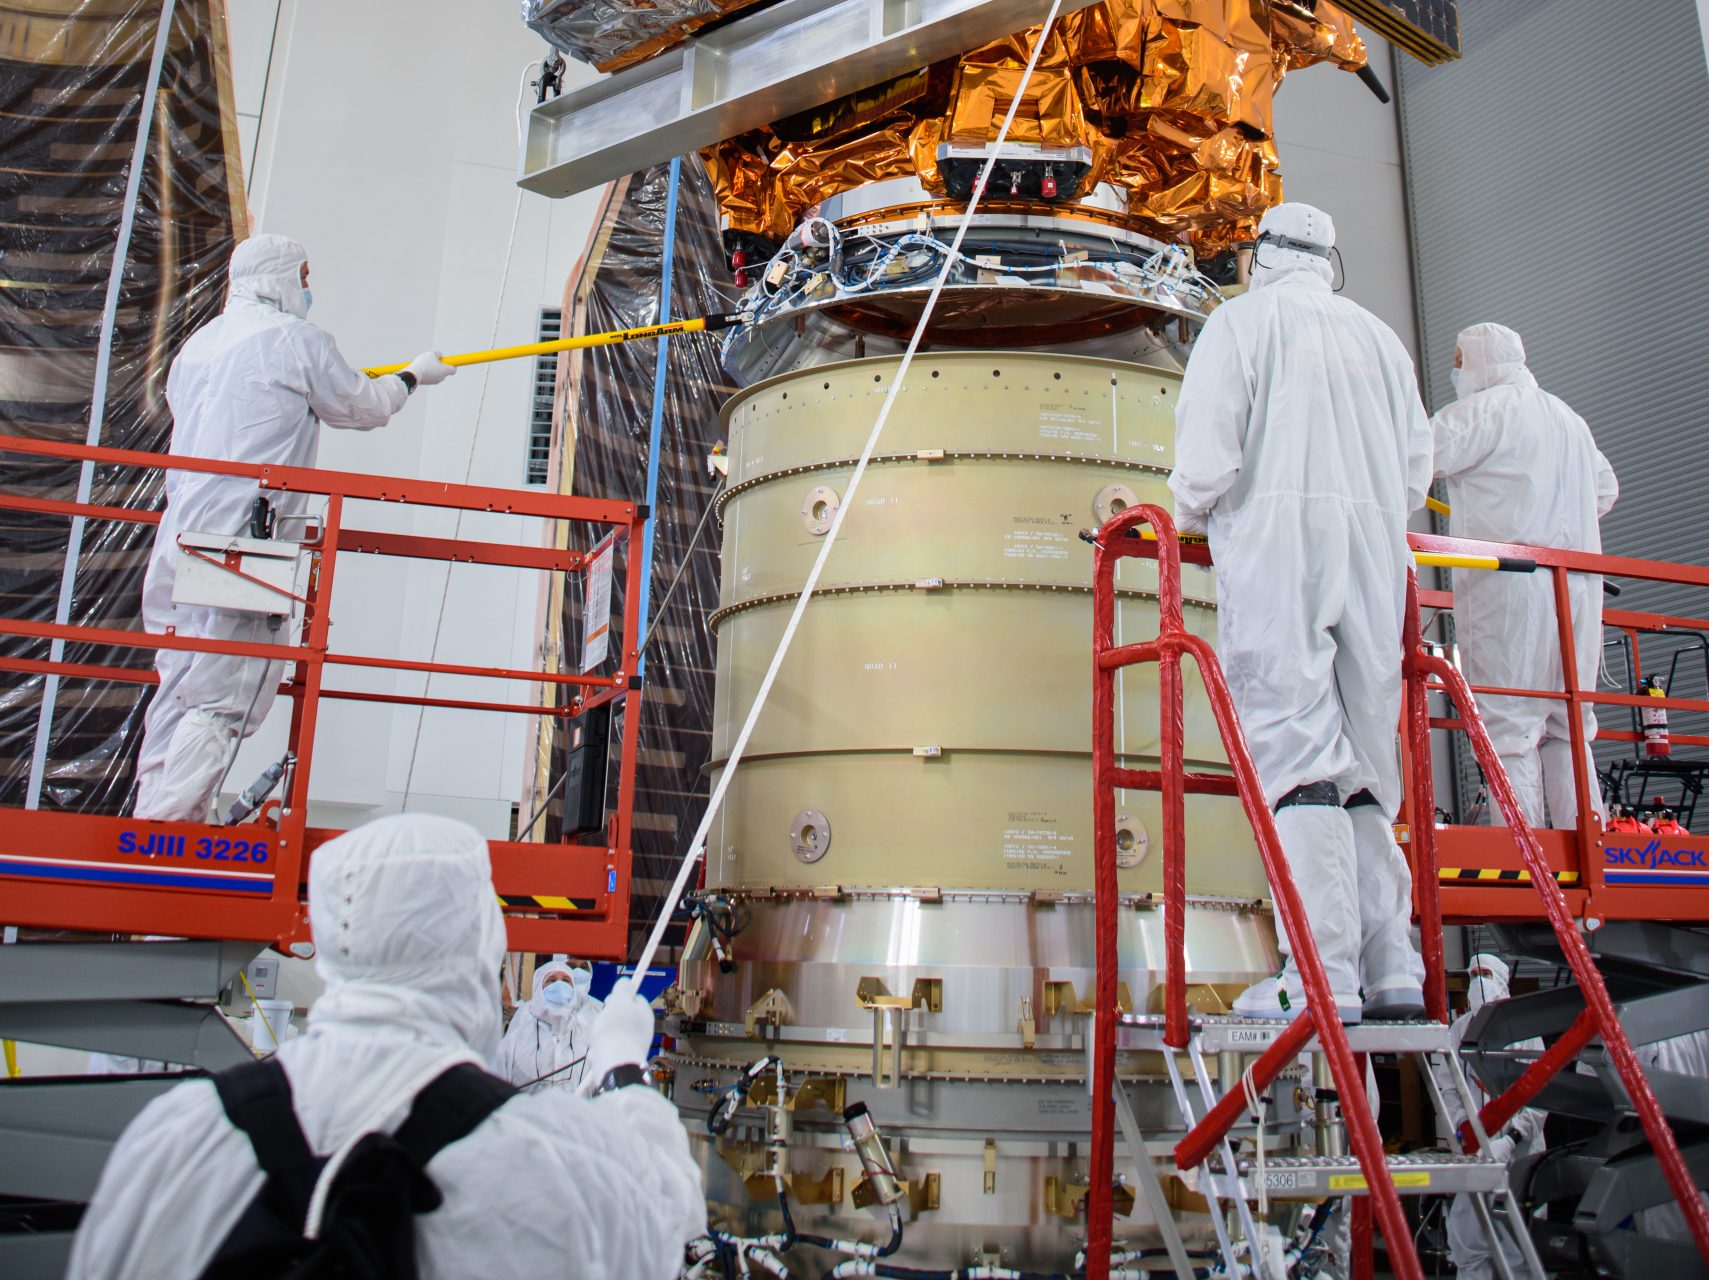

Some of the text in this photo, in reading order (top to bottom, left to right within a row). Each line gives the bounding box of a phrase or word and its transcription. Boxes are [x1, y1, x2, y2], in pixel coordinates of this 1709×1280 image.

[118, 831, 270, 864] SJIII 3226
[1604, 839, 1707, 869] SKYJACK
[1231, 1031, 1257, 1041] EAM#
[1264, 1174, 1293, 1187] 5306
